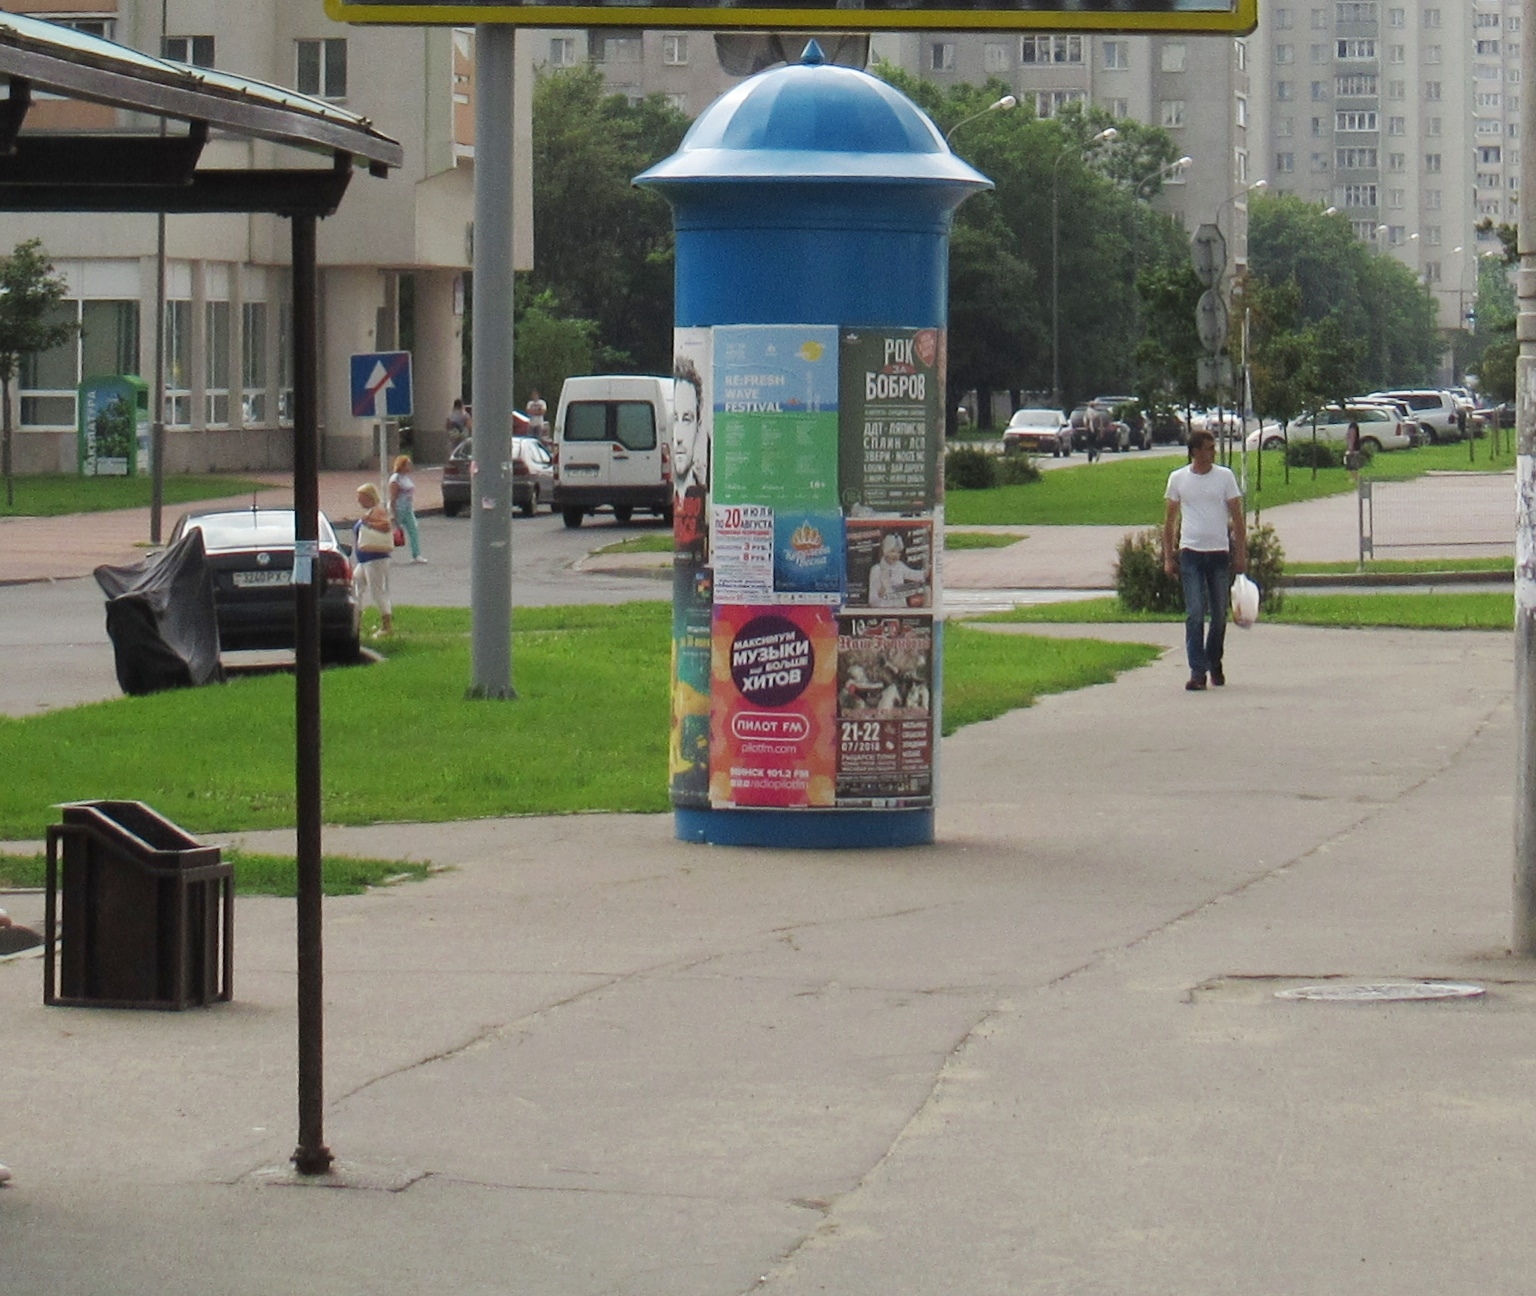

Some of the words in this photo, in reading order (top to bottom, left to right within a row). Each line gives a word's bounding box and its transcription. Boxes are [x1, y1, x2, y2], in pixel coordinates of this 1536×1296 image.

[884, 338, 915, 366] РОК
[892, 366, 907, 374] ЗА
[725, 374, 785, 386] RE:FRESH
[865, 371, 926, 401] БОБРОВ
[725, 388, 760, 399] WAVE
[725, 401, 783, 413] FESTIVAL
[863, 436, 901, 450] СПЛИН
[724, 508, 741, 529] 20
[743, 507, 773, 517] ИЮЛЯ
[740, 519, 773, 529] АВГУСТА
[733, 631, 796, 651] МАКСИМУМ
[732, 639, 809, 667] МУЗЫКИ
[765, 656, 809, 673] БОЛЬШЕ
[741, 668, 801, 693] ХИТОВ
[737, 719, 777, 732] ПИЛОТ
[782, 723, 803, 733] FM
[841, 721, 881, 742] 21-22
[741, 742, 798, 754] pilotfm.com
[730, 767, 765, 777] МИНСК
